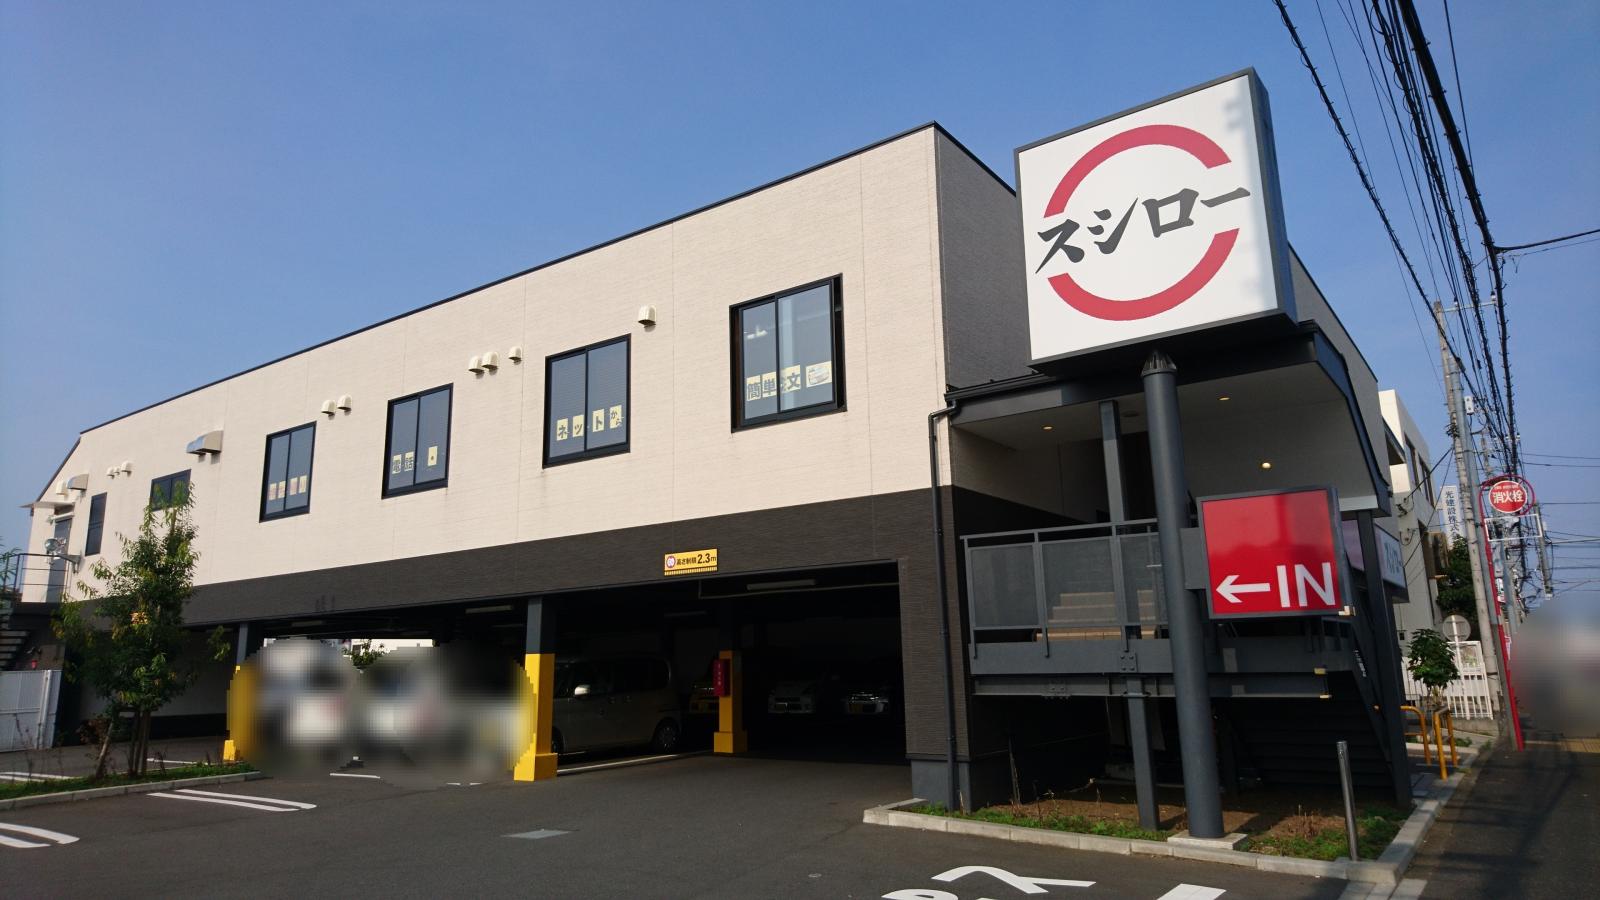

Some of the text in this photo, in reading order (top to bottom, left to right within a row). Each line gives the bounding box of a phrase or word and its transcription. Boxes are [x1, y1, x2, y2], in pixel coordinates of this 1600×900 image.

[1035, 187, 1250, 274] スシロー
[1492, 490, 1524, 504] 消火栓
[1276, 562, 1336, 608] IN
